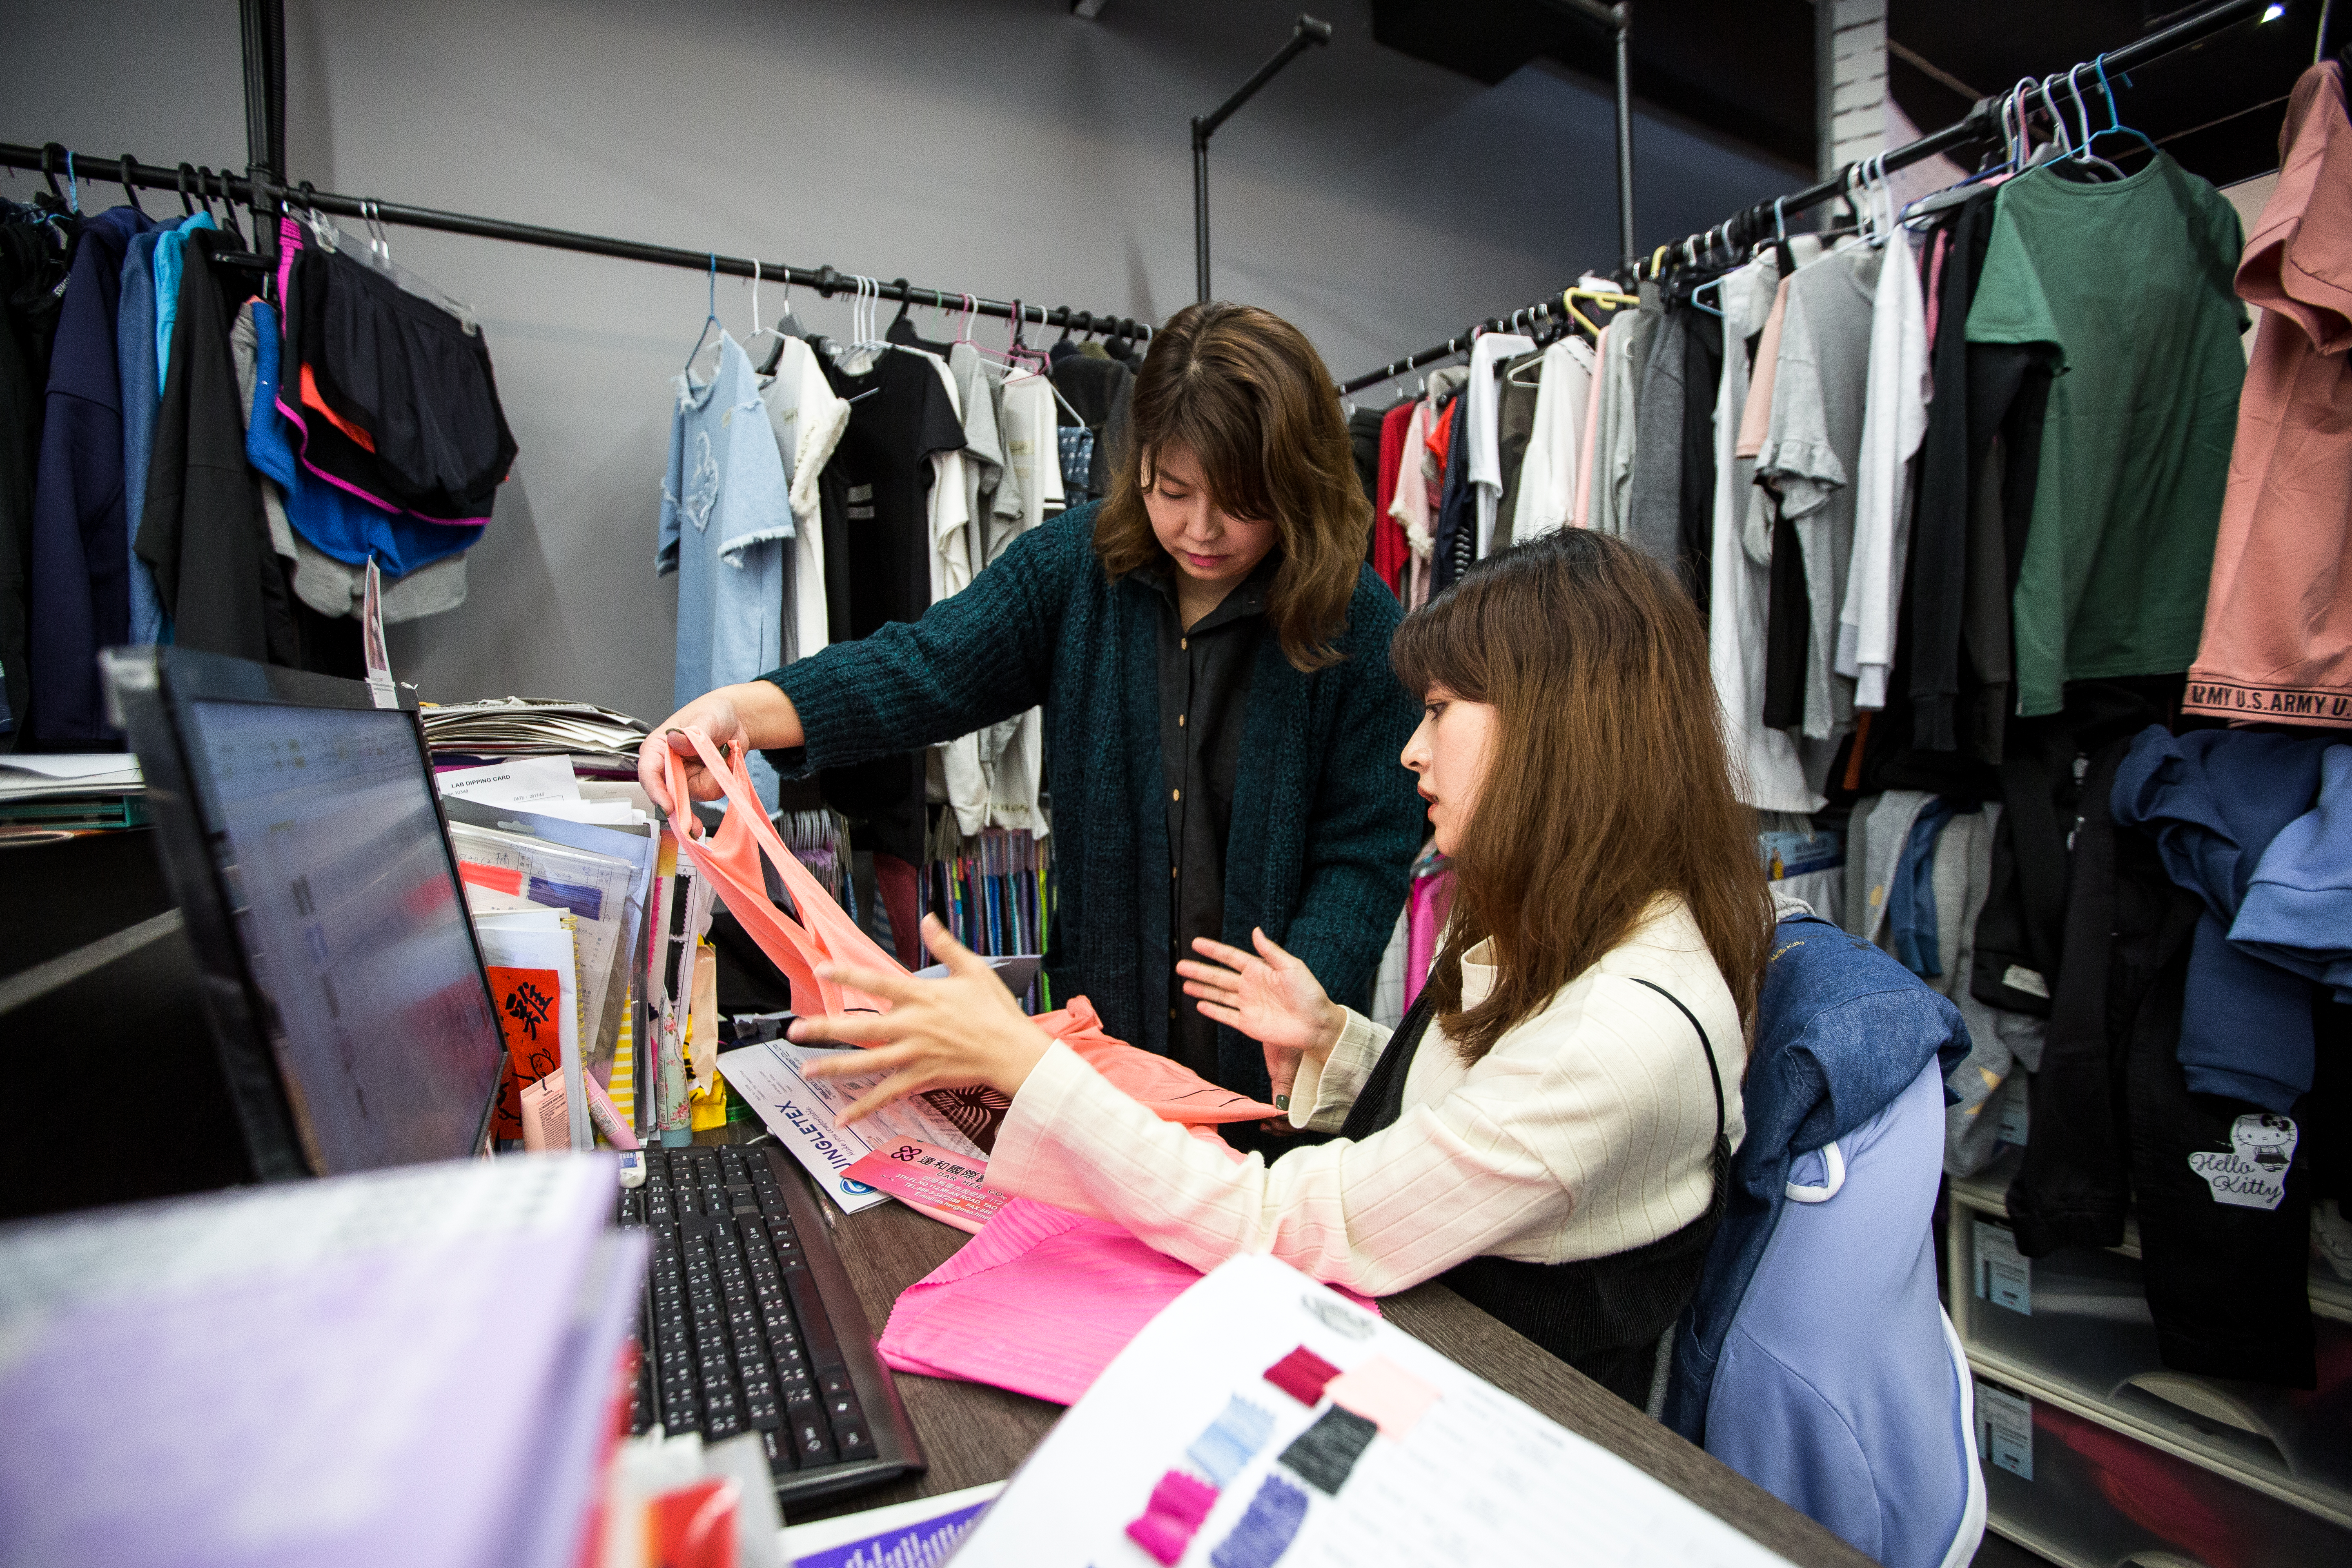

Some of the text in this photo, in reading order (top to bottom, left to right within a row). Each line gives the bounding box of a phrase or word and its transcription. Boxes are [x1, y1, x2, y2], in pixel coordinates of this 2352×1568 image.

[2271, 693, 2326, 714] ARMY
[466, 777, 492, 786] DIPPING
[774, 1100, 852, 1169] JINGLETEX
[831, 1133, 846, 1143] you
[841, 1143, 856, 1156] Make
[2190, 1153, 2255, 1174] Hello
[937, 1172, 957, 1181] DAR
[962, 1180, 982, 1190] HER
[2212, 1175, 2282, 1203] Kitty
